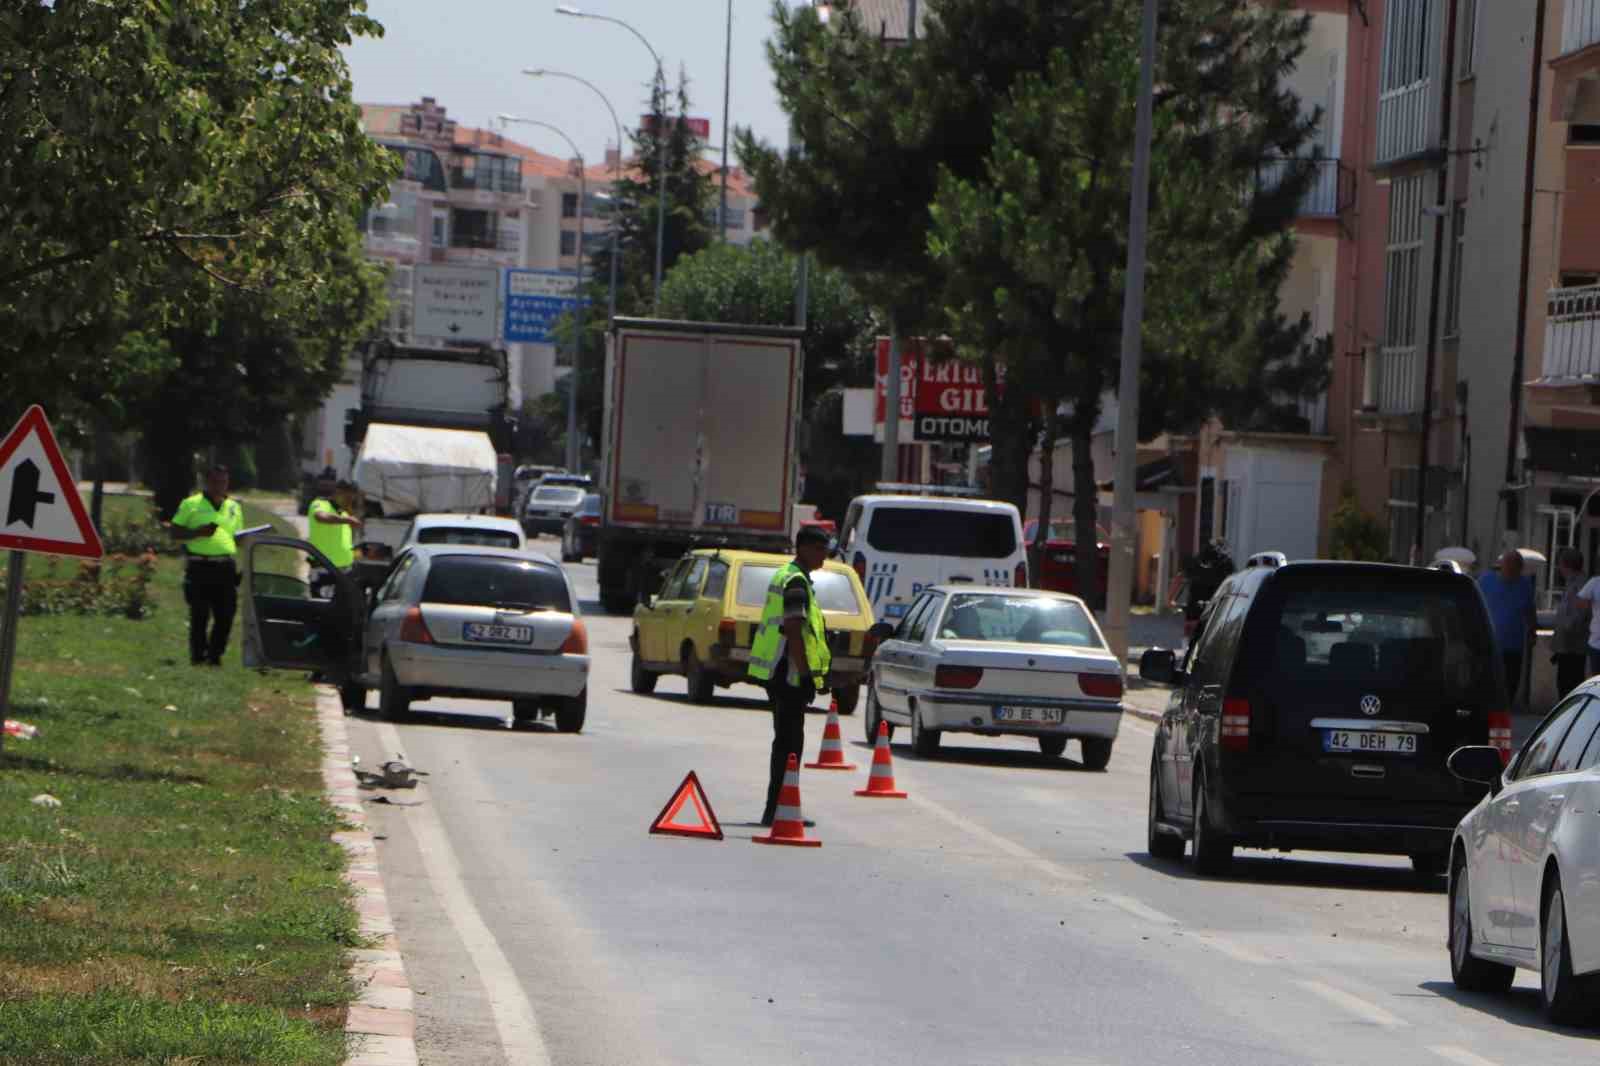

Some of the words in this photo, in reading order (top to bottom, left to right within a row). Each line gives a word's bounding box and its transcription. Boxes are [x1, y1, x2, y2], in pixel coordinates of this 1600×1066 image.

[1332, 733, 1350, 748] 42
[1360, 734, 1387, 750] DEH
[1398, 735, 1416, 751] 79
